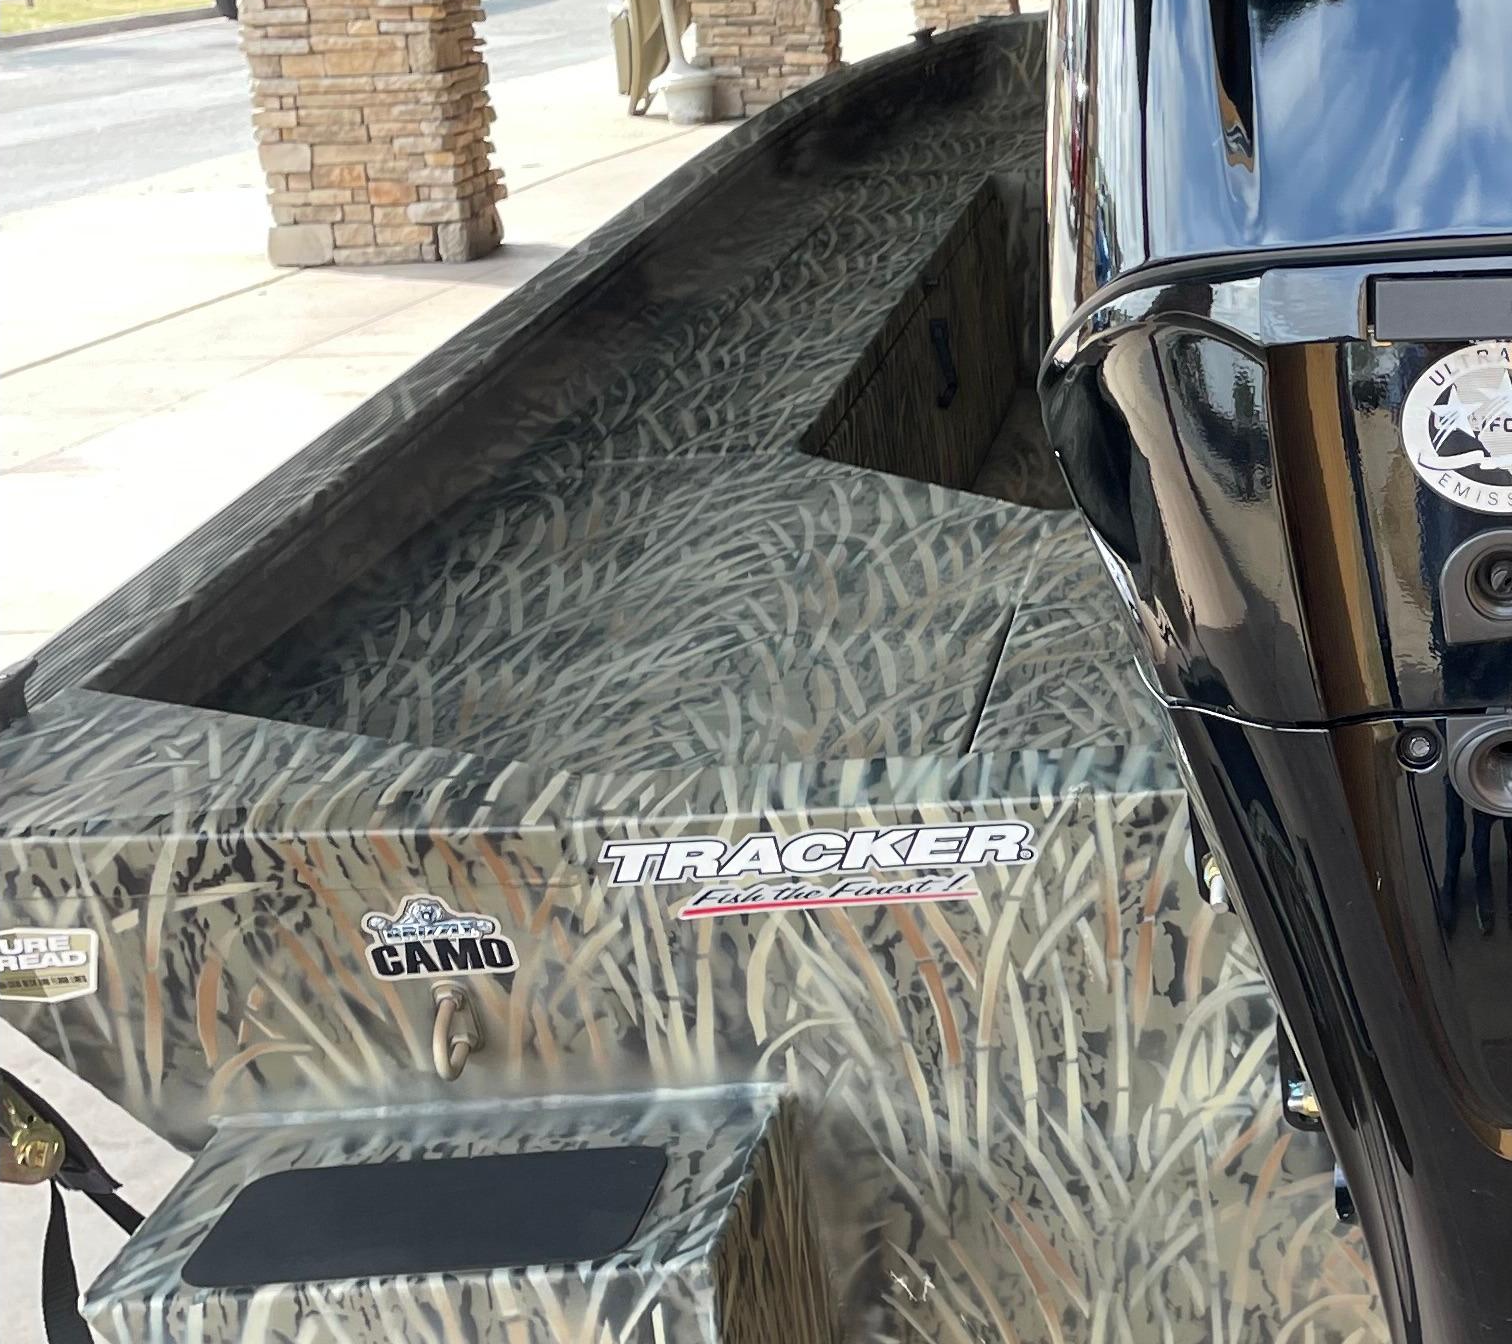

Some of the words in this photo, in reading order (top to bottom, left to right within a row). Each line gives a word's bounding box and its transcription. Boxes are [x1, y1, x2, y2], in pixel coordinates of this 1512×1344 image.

[604, 823, 1030, 884] TRACKER
[692, 887, 766, 906] Fish
[773, 884, 821, 901] the
[371, 937, 514, 976] CAMO
